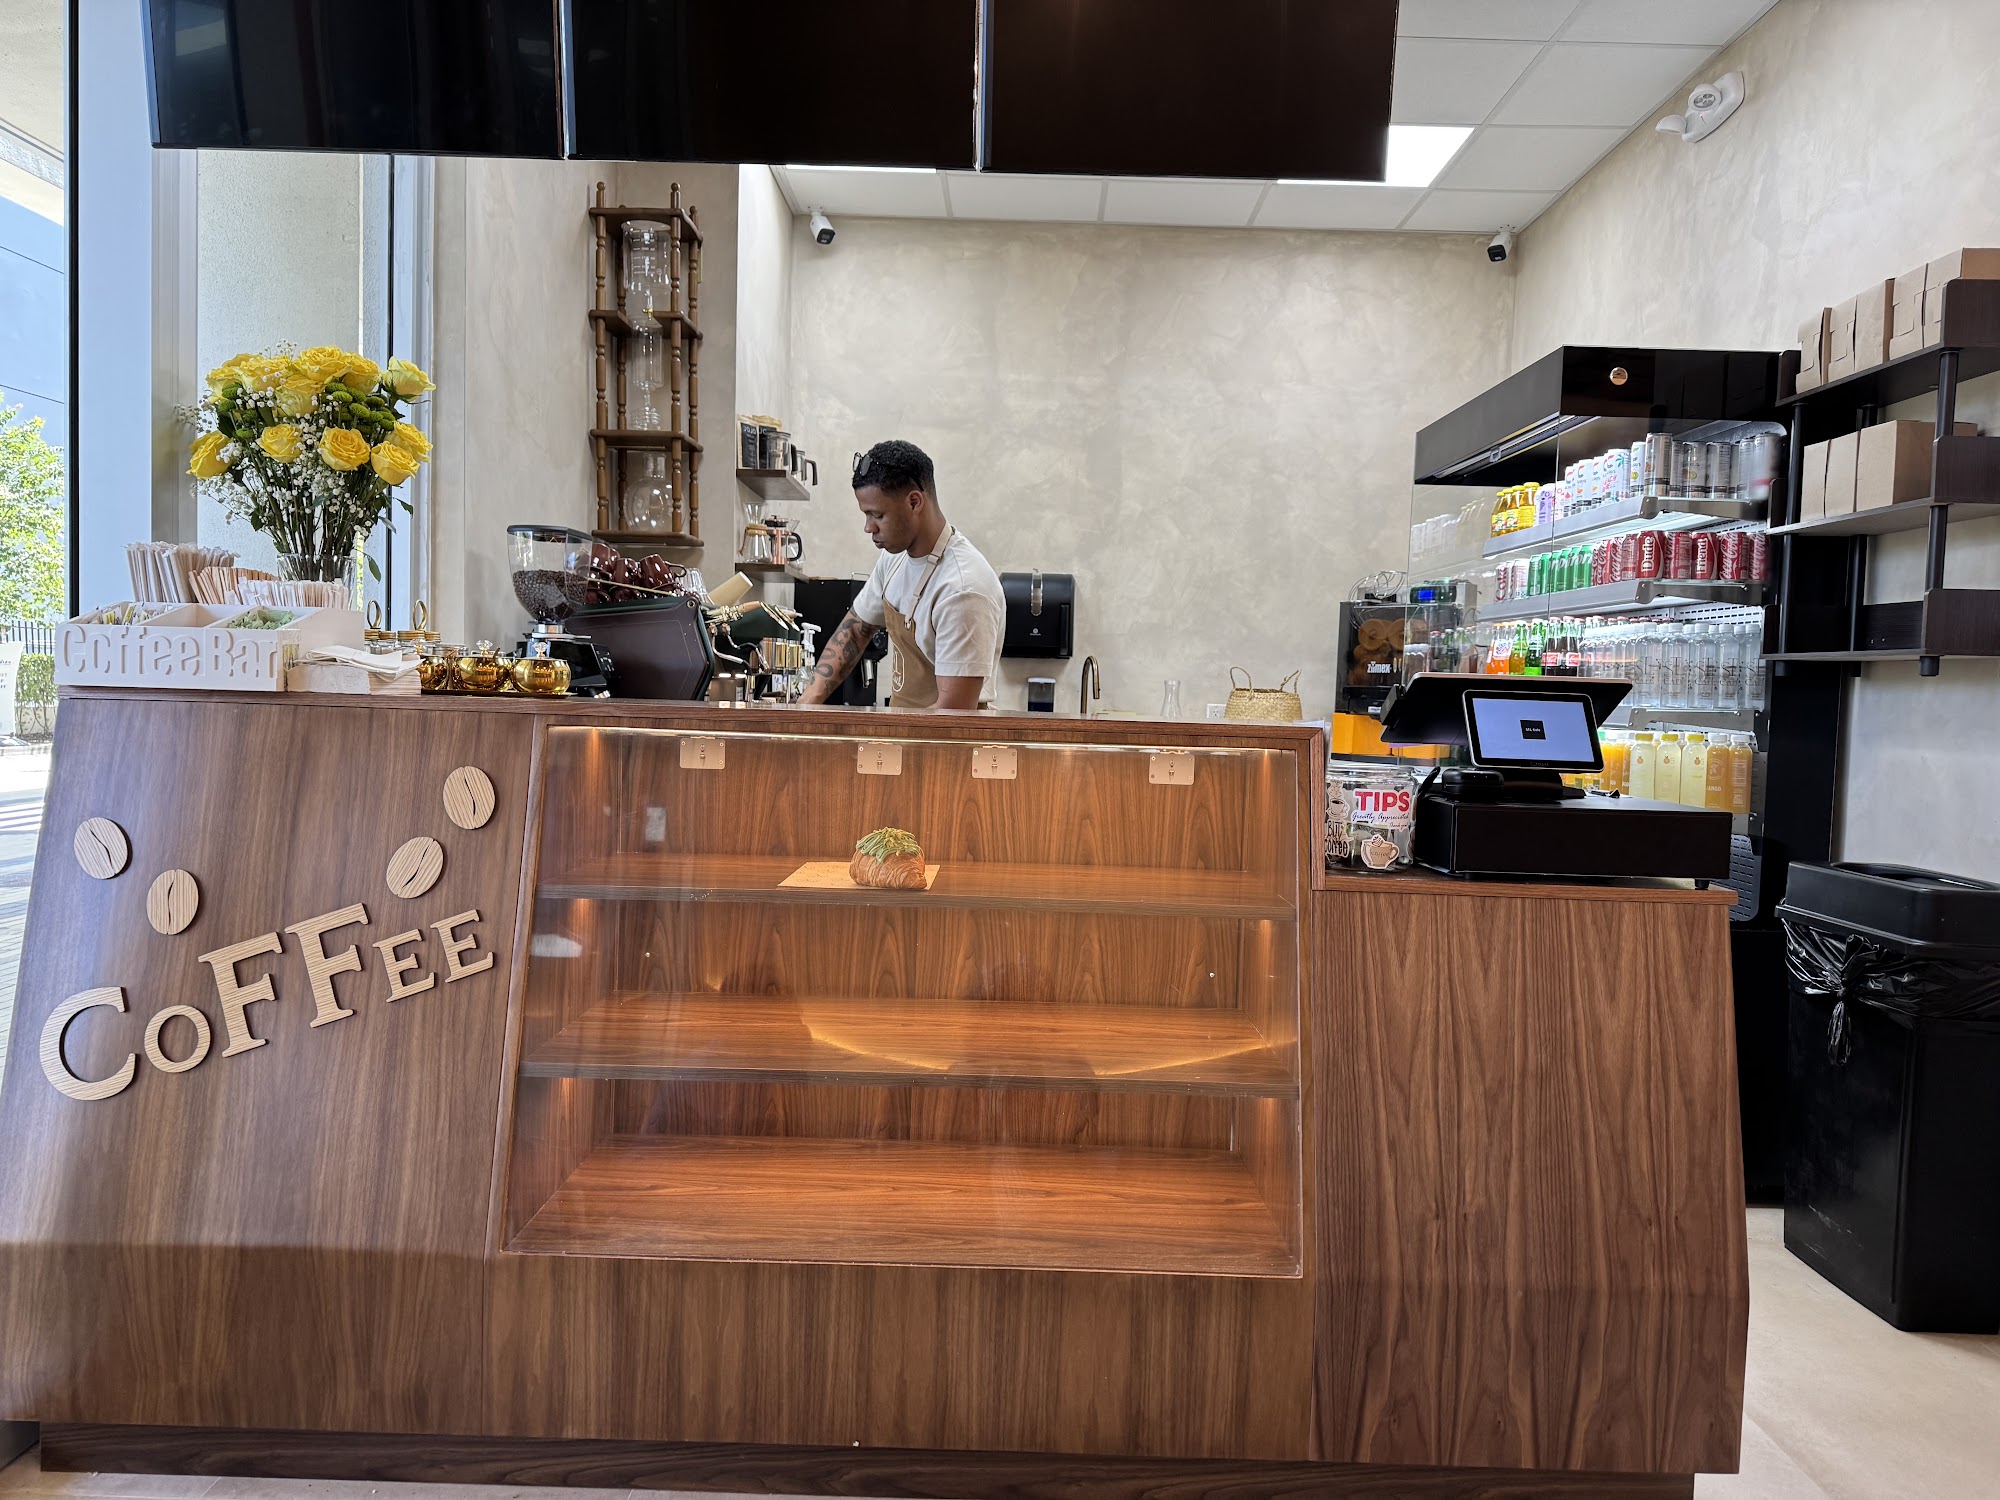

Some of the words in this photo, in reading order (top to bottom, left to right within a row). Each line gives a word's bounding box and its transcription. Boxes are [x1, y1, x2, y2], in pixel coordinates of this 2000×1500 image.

[1641, 536, 1656, 573] Dude
[1696, 537, 1708, 574] Friend
[57, 624, 201, 677] Coffee
[204, 628, 278, 679] Bar
[1352, 812, 1375, 823] Greatly
[1377, 812, 1410, 822] Appreciated
[1355, 791, 1410, 812] TIPS
